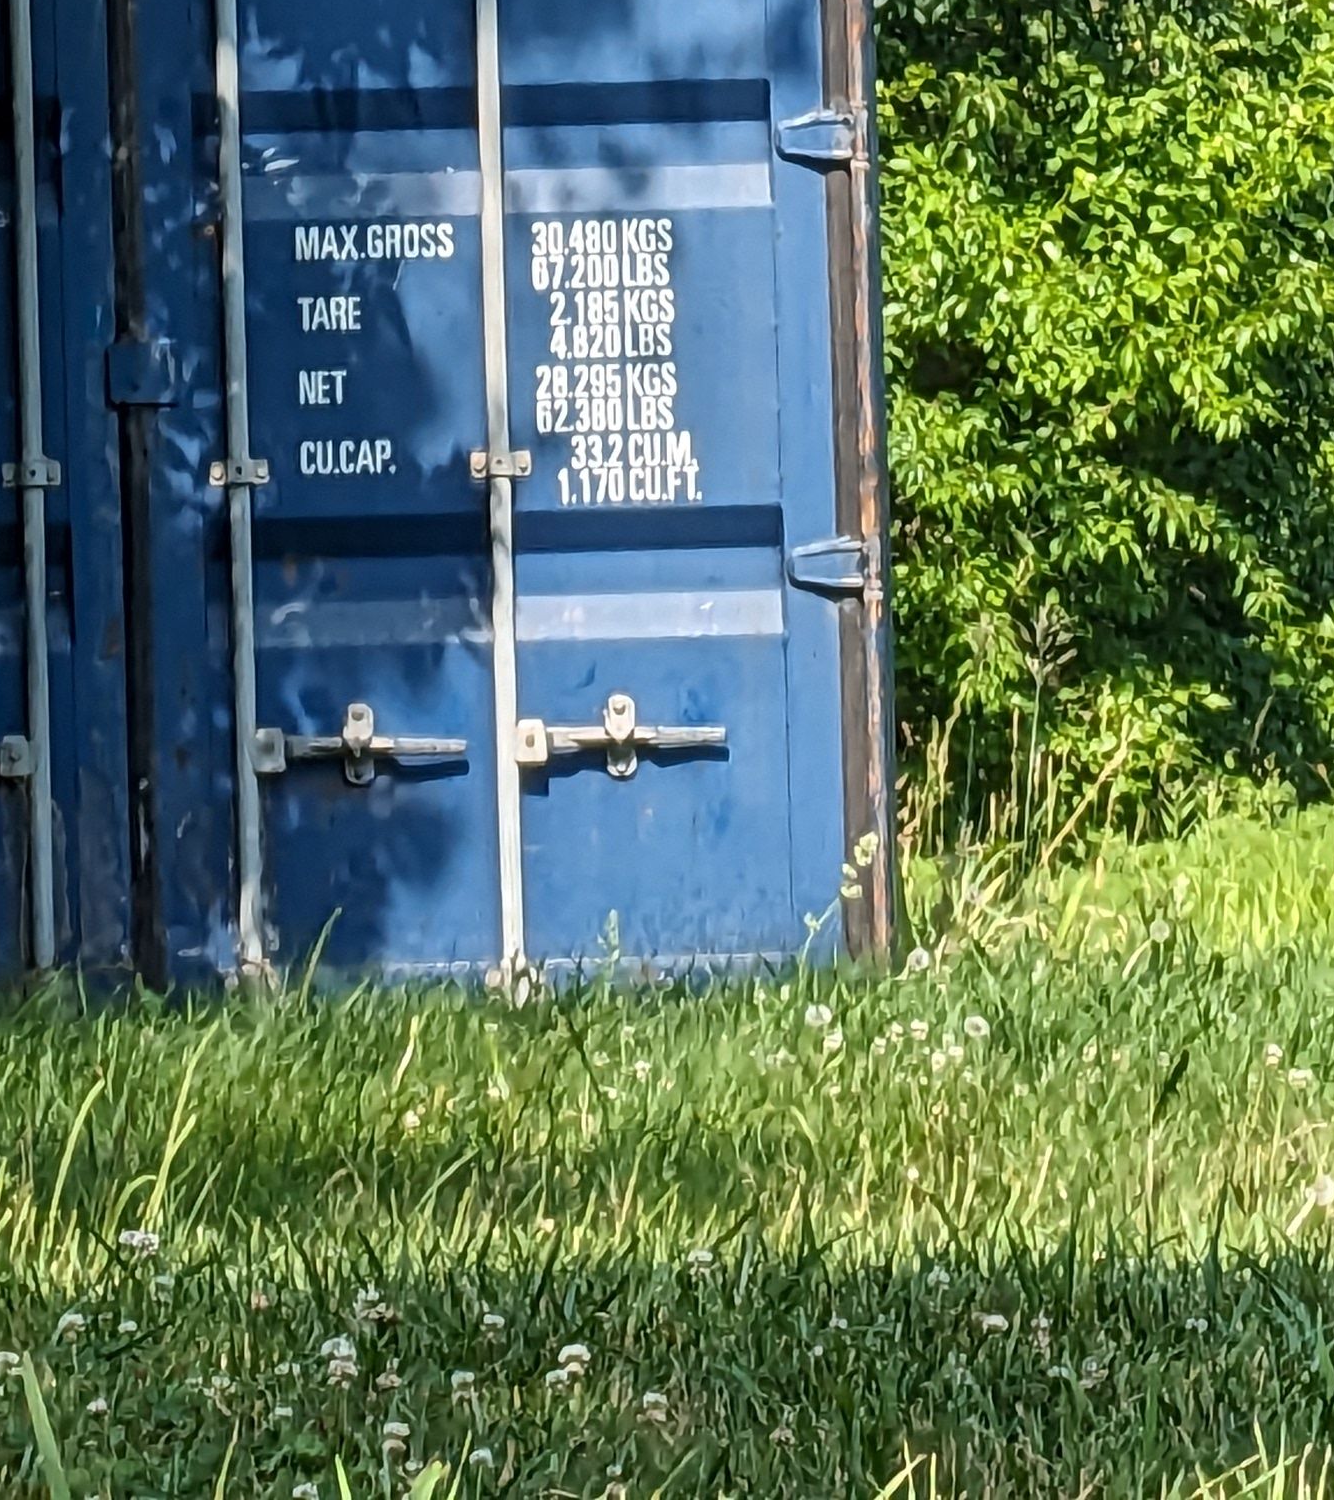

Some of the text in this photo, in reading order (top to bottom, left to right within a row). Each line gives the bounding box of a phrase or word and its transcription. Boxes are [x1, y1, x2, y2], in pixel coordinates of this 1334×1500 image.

[294, 217, 673, 262] MAX.GROSS 30.480 KGS
[531, 253, 671, 290] 67.200 LBS
[297, 288, 675, 333] TARE 2.185 KGS
[549, 323, 673, 360] 4.820 LBS
[298, 361, 678, 406] NET 28.295 KGS
[536, 396, 675, 434] 62.380 LBS
[299, 430, 699, 476] CU.CAP. 33.2 CU.M.
[557, 465, 703, 506] 1.170 CU.FT.
